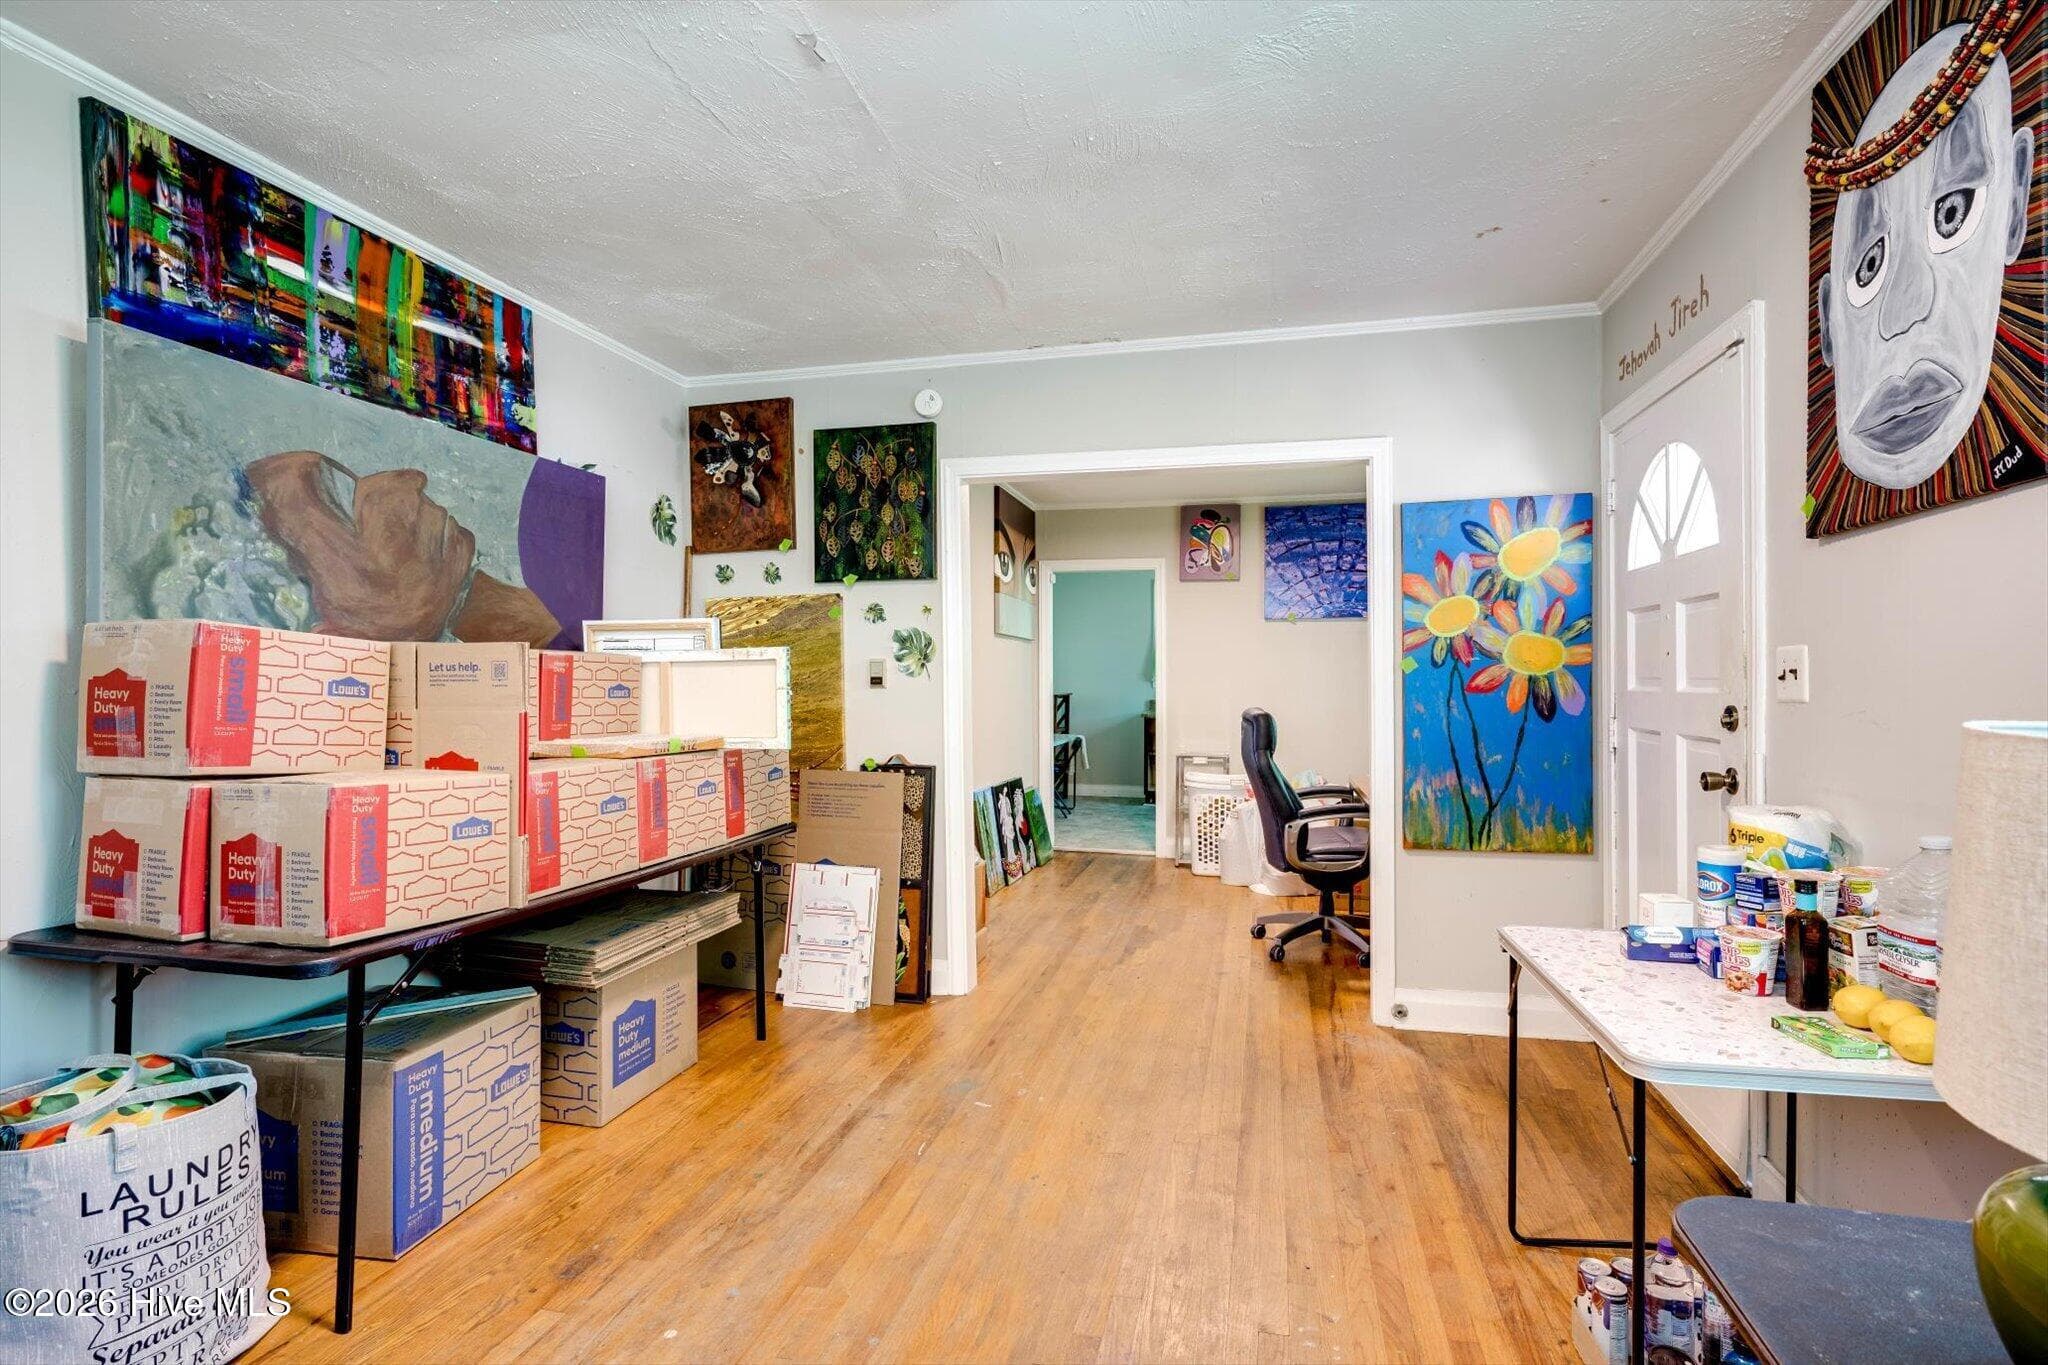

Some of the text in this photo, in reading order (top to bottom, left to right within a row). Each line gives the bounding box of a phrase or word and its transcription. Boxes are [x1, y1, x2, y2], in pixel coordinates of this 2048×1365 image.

[1618, 273, 1709, 381] Jehovah Jireh
[220, 643, 244, 655] Duty
[221, 636, 251, 647] Heavy
[429, 661, 482, 673] Let us help.
[95, 687, 130, 702] Heavy
[332, 685, 366, 696] LOWE'S
[94, 701, 120, 714] Duty
[386, 753, 396, 763] E'S
[352, 796, 380, 805] Heavy
[352, 804, 374, 814] Duty
[457, 825, 489, 839] LOWE'S
[1730, 828, 1765, 844] 6 Triple
[94, 847, 123, 863] Heavy
[229, 852, 265, 868] Heavy
[92, 863, 115, 877] Duty
[228, 867, 256, 882] Duty
[1697, 878, 1723, 893] OROX
[618, 1015, 646, 1033] Heavy
[545, 1029, 581, 1044] LOWE'S
[618, 1029, 639, 1048] Duty
[618, 1037, 651, 1061] medium
[408, 1064, 438, 1085] Heavy
[408, 1079, 431, 1096] Duty
[496, 1071, 528, 1097] LOWE'S
[320, 1140, 343, 1149] Family
[419, 1089, 438, 1203] medium
[320, 1150, 343, 1159] Dining
[80, 1124, 259, 1218] LAUNDRY
[122, 1155, 250, 1234] RULES
[408, 1172, 416, 1209] mediano
[320, 1208, 340, 1216] Gara
[82, 1188, 261, 1290] IT'S A DIRTY JOB
[84, 1246, 129, 1269] You
[136, 1224, 182, 1250] wear
[187, 1216, 198, 1229] it
[204, 1201, 229, 1221] you
[123, 1250, 203, 1293] SOMEONES
[208, 1233, 231, 1252] GOT
[232, 1223, 244, 1238] TO
[199, 1241, 242, 1278] DROP
[203, 1265, 226, 1291] IT
